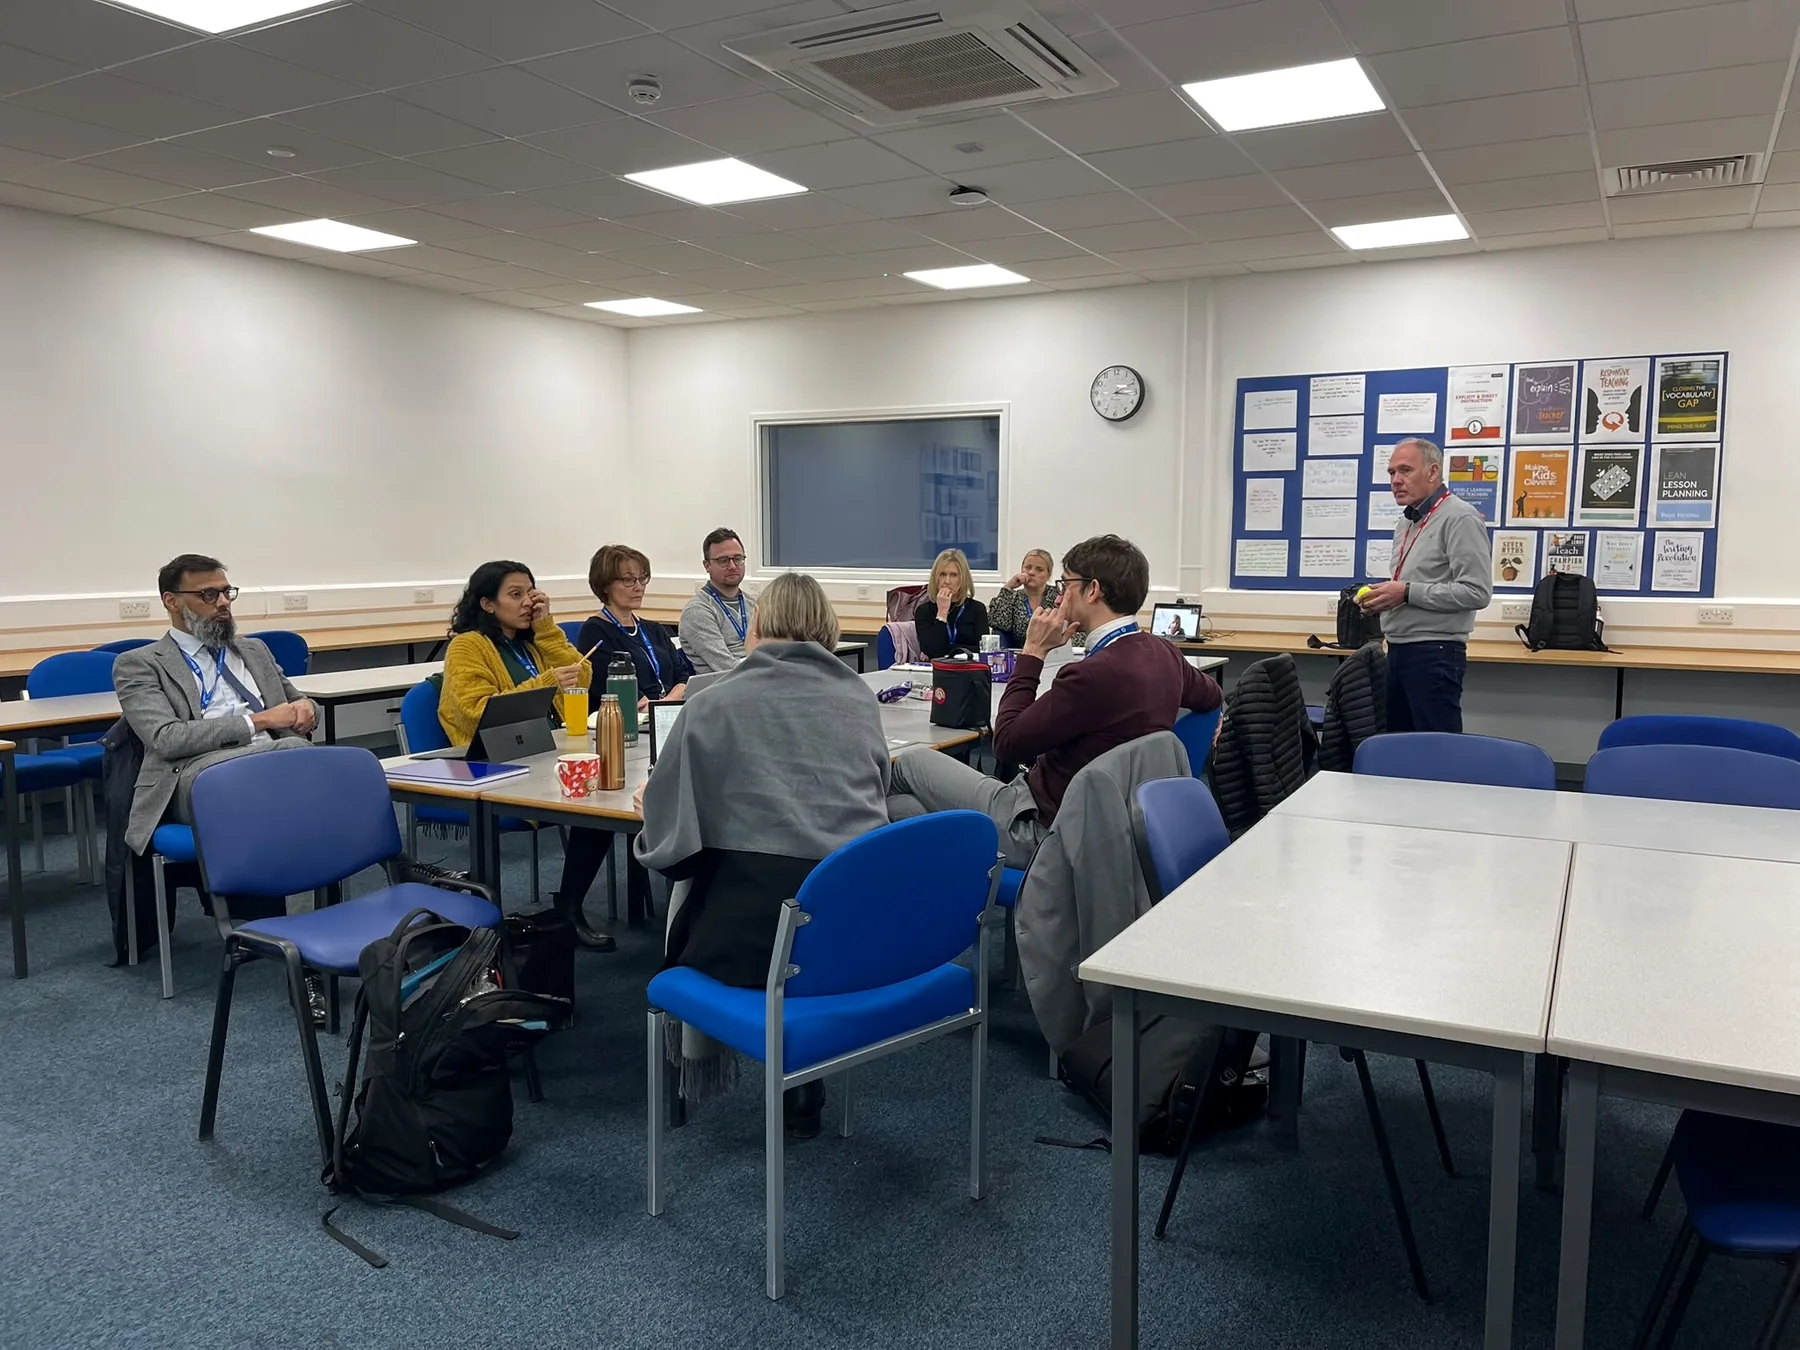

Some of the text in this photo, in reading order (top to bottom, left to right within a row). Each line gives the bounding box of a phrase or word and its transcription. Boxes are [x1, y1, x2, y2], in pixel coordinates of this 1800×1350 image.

[1600, 368, 1630, 376] RESPONSIVE
[1600, 377, 1628, 388] TEACHING
[1678, 399, 1700, 408] GAP
[1524, 464, 1548, 472] Making
[1532, 470, 1557, 480] Kids
[1663, 472, 1687, 480] LEAN
[1662, 481, 1697, 489] LESSON
[1662, 490, 1708, 498] PLANNING
[1556, 547, 1579, 555] Teach
[1663, 543, 1693, 555] Writing
[1657, 552, 1697, 562] Revolution
